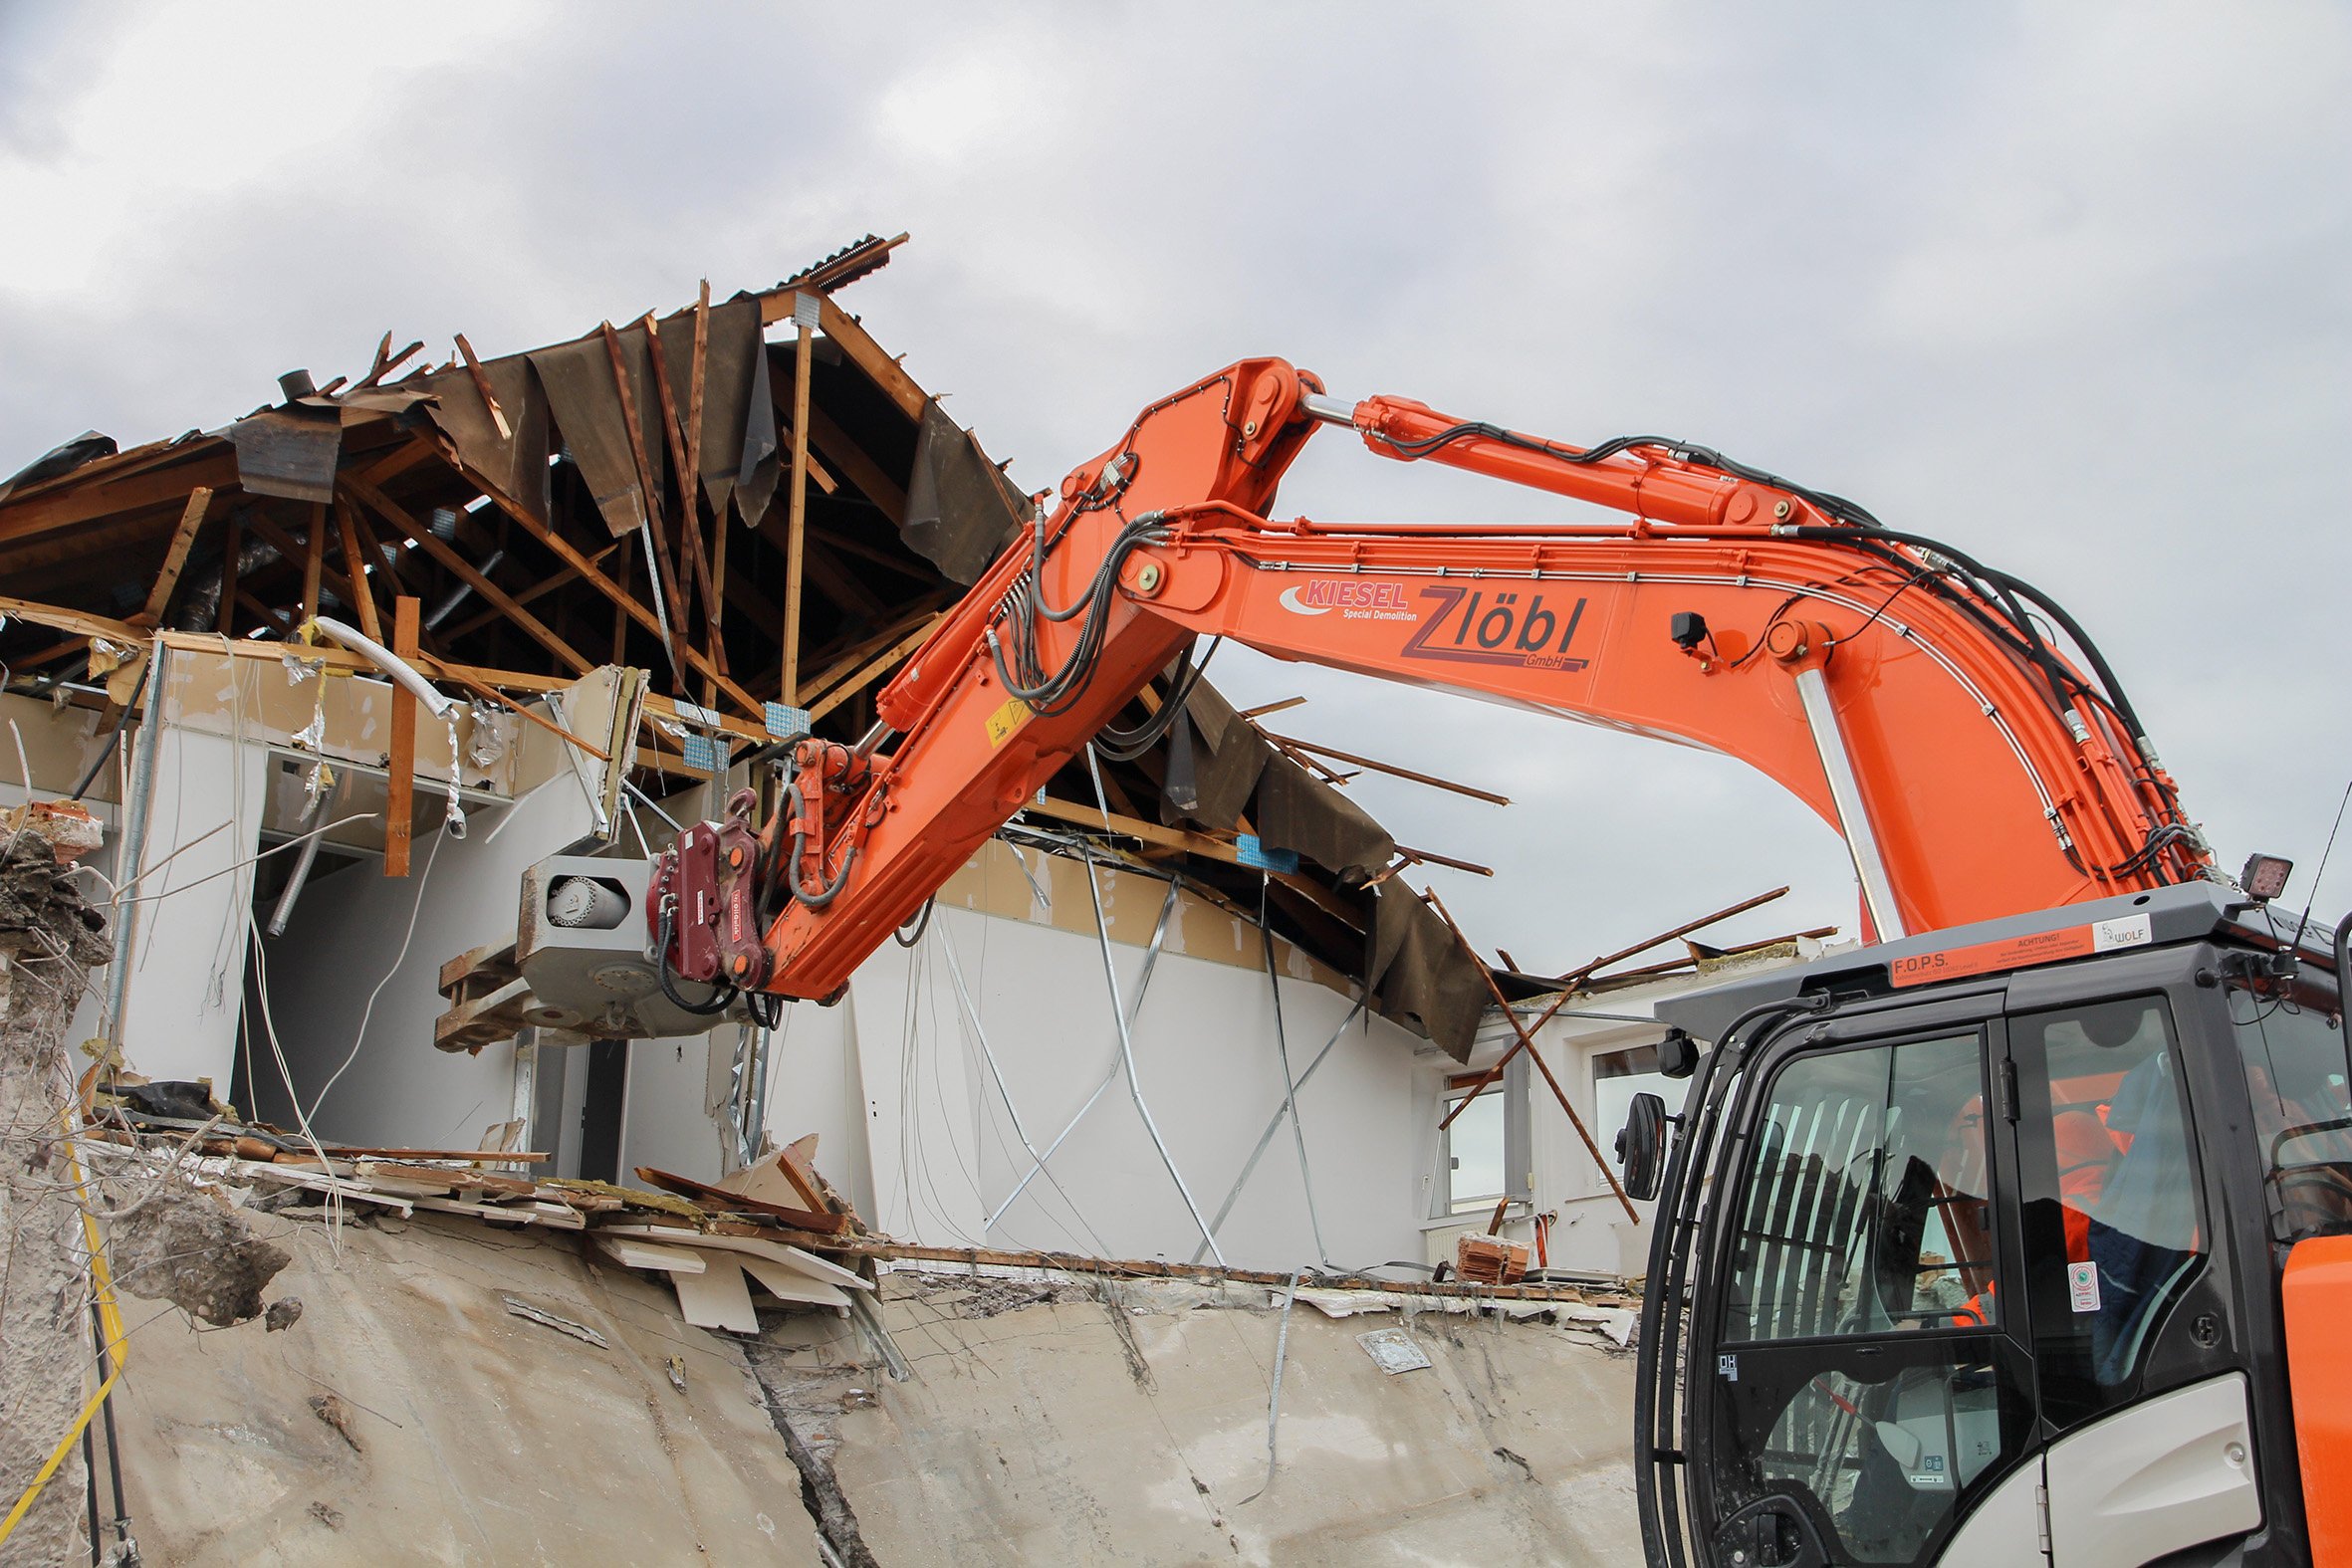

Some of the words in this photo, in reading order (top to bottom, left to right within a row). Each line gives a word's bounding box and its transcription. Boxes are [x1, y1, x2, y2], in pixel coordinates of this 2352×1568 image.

[1305, 580, 1409, 609] KIESEL
[1343, 608, 1372, 619] Special
[1374, 609, 1417, 621] Demolition
[1400, 585, 1589, 672] Zlöbl
[1527, 653, 1564, 668] GmbH
[2017, 933, 2060, 947] ACHTUNG!
[2115, 929, 2145, 943] WOLF
[1894, 953, 1950, 974] F.O.P.S.
